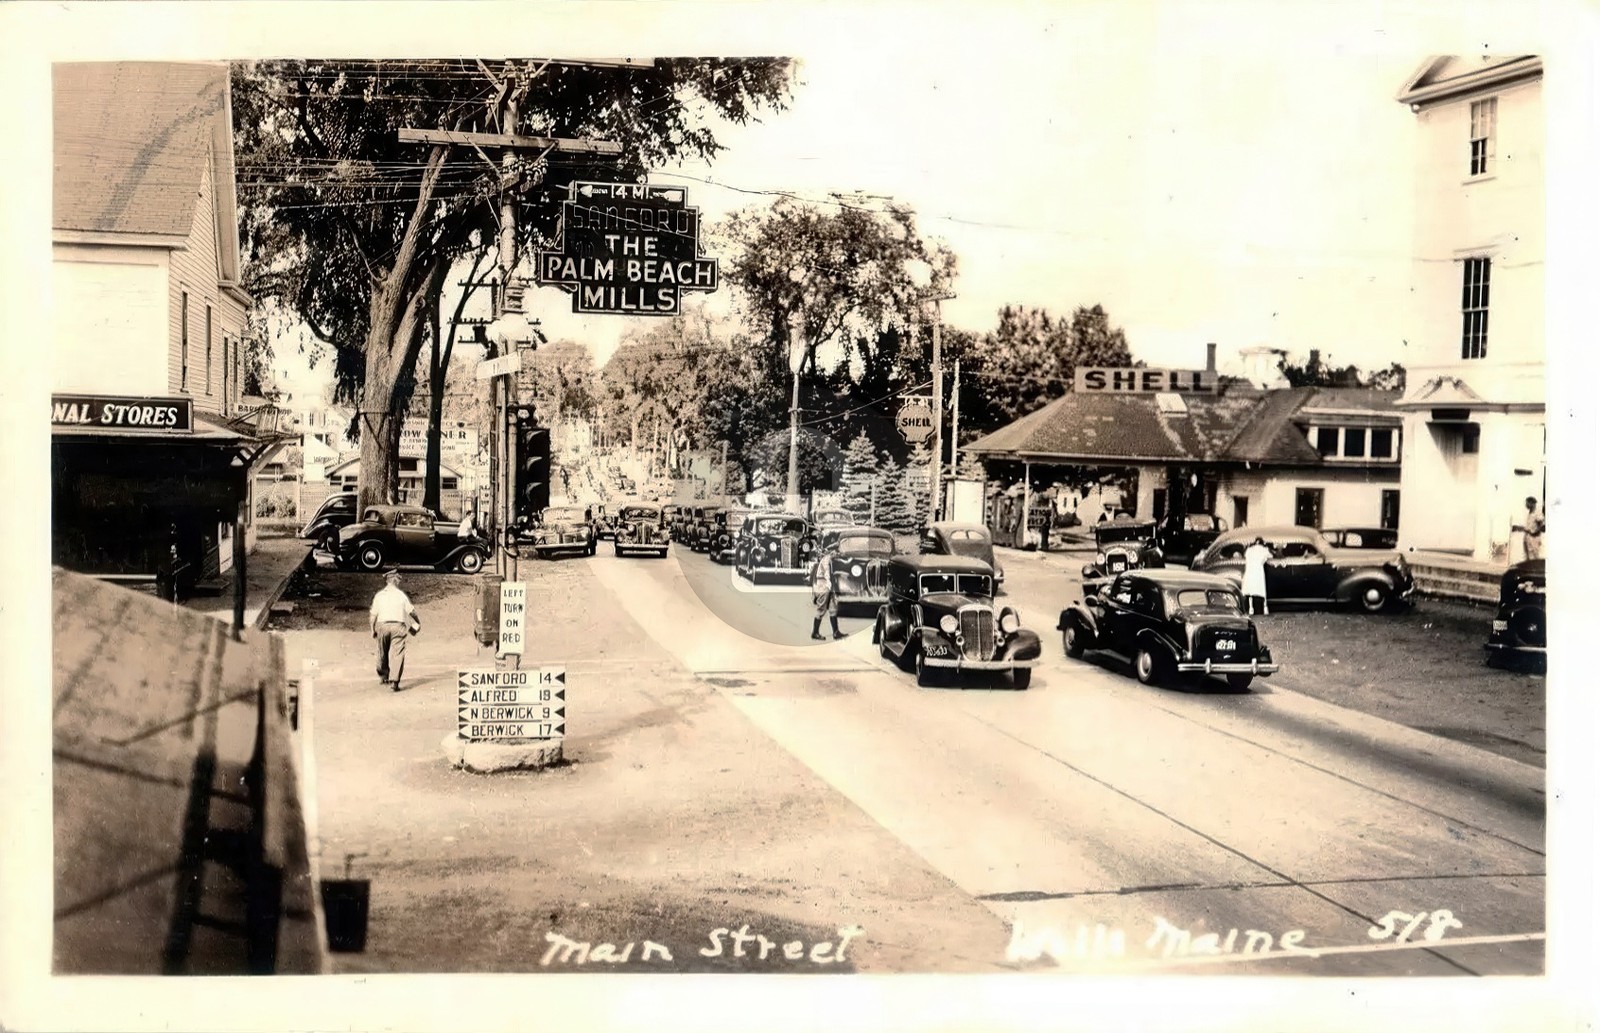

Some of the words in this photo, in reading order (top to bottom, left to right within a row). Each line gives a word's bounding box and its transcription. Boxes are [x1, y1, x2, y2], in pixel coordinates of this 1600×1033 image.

[611, 184, 627, 199] 14
[605, 234, 658, 257] THE
[548, 256, 614, 281] PALM
[627, 259, 712, 285] BEACH
[584, 285, 675, 310] MILLS
[1085, 371, 1212, 391] SHELL
[51, 402, 91, 423] NAL
[101, 404, 178, 426] STORES
[901, 418, 931, 428] SHELL
[503, 589, 524, 598] LEFT
[503, 603, 524, 613] TURN
[506, 619, 519, 628] ON
[502, 633, 521, 643] RED
[471, 672, 527, 685] SANFORD
[539, 672, 552, 684] 14
[471, 690, 517, 702] ALFRED
[471, 707, 479, 719] N
[481, 707, 534, 719] BERWICK
[542, 706, 551, 718] 9
[471, 724, 524, 737] BERWICK
[539, 724, 552, 737] 17
